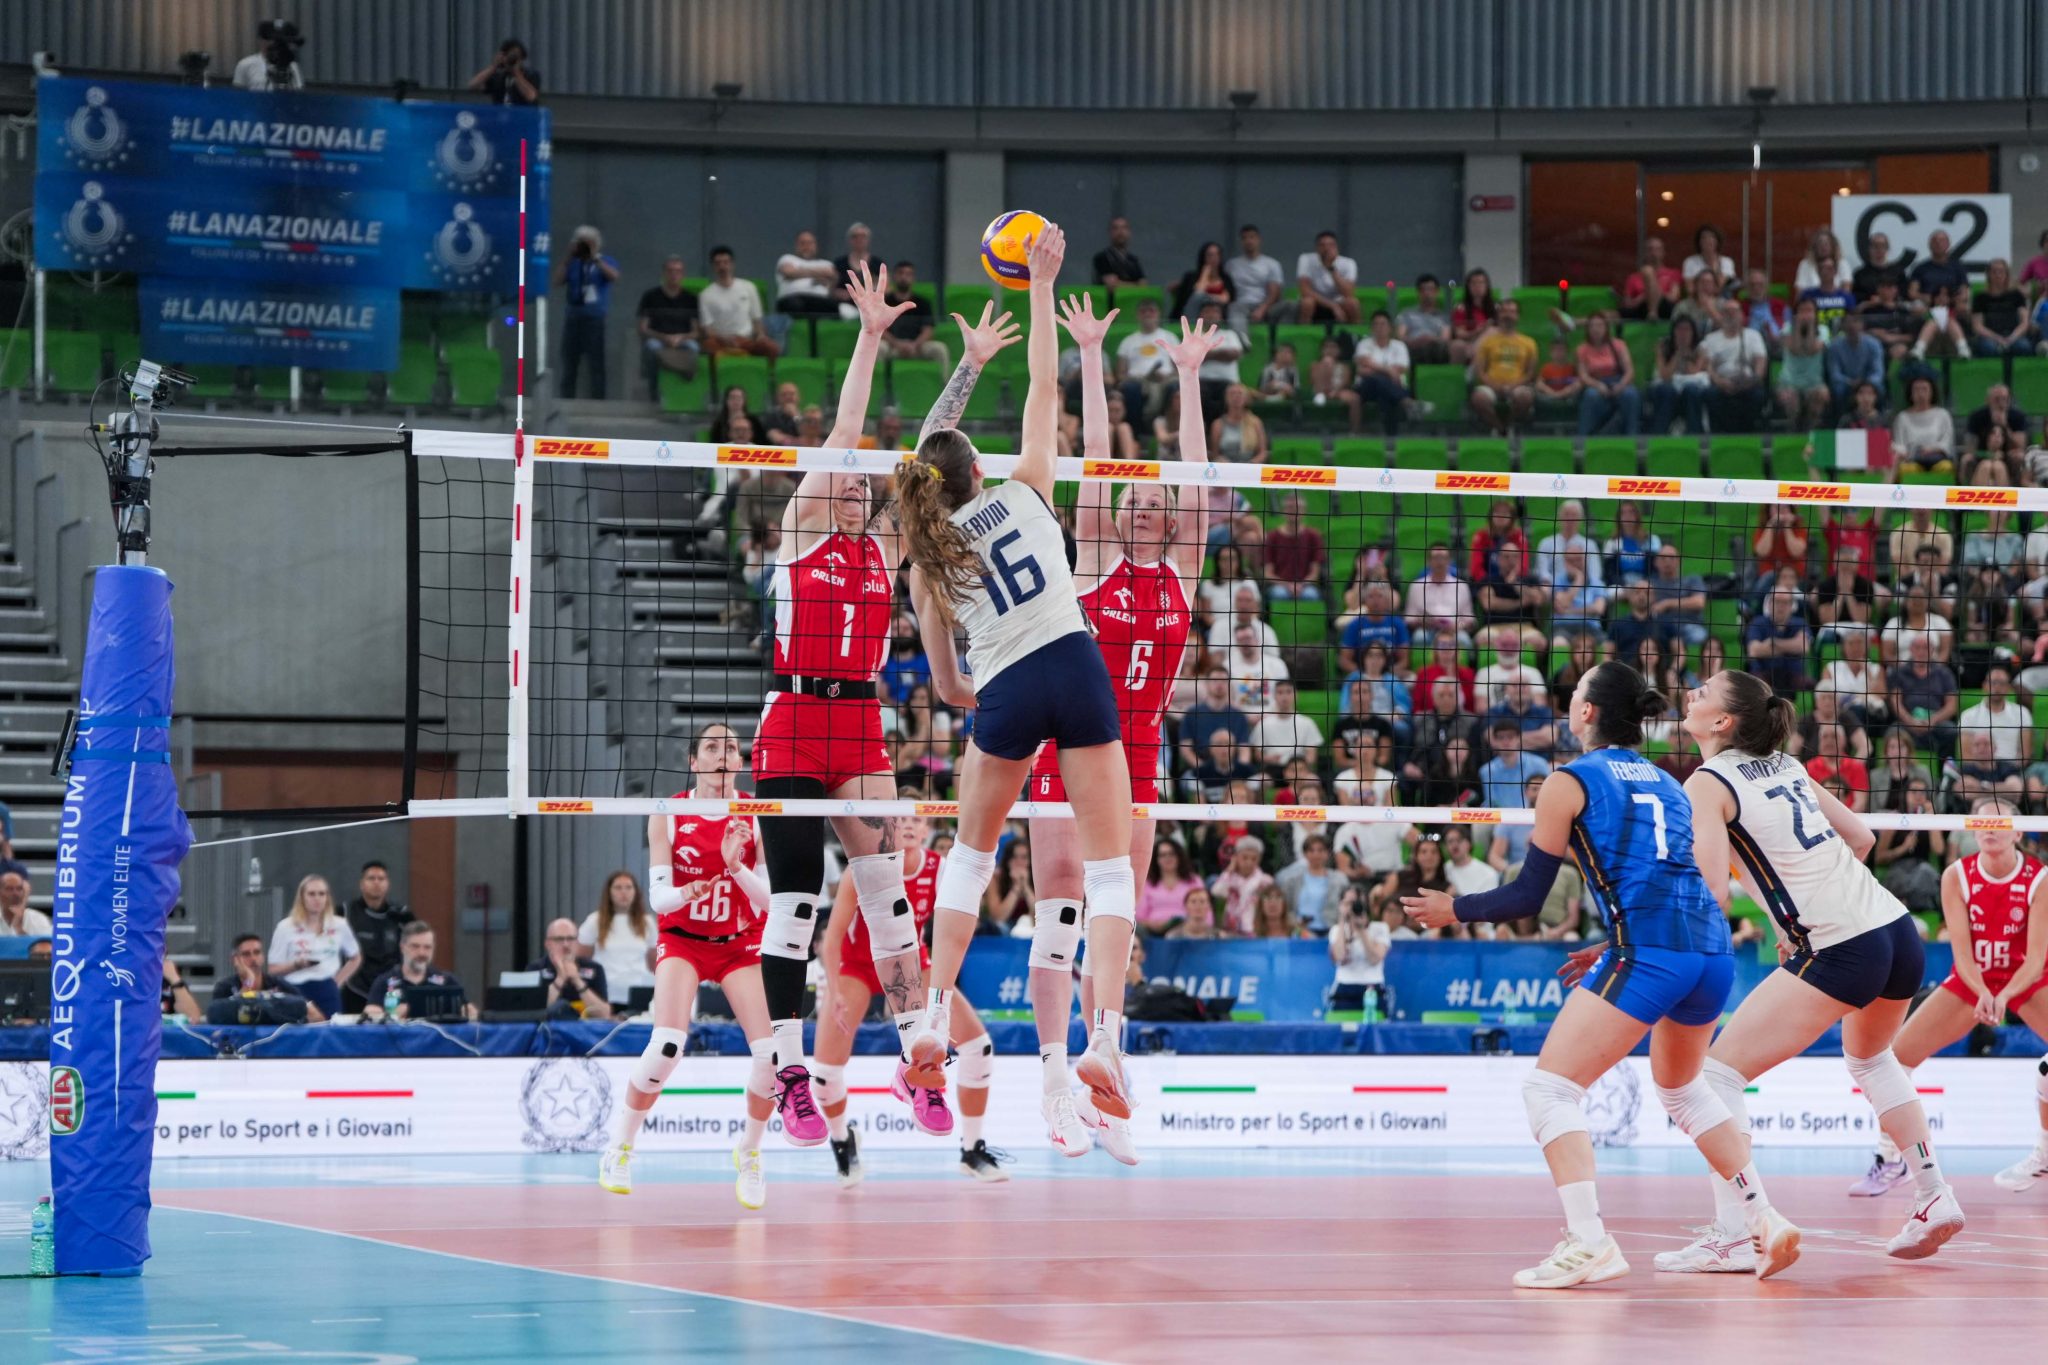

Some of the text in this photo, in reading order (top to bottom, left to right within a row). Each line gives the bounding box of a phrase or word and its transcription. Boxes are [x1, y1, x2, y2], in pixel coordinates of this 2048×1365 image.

[170, 116, 387, 150] #LANAZIONALE
[167, 211, 383, 243] #LANAZIONALE
[161, 297, 376, 328] #LANAZIONALE
[538, 441, 600, 456] DHL
[728, 449, 785, 464] DHL
[1094, 463, 1150, 477] DHL
[1272, 469, 1325, 483] DHL
[1446, 475, 1499, 489] DHL
[1618, 480, 1671, 493] DHL
[1787, 486, 1840, 499] DHL
[1956, 491, 2008, 504] DHL
[960, 499, 1010, 542] ERVINI
[811, 568, 845, 588] ORLEN
[975, 528, 1046, 617] 16
[862, 579, 886, 595] plus
[1102, 606, 1137, 625] ORLEN
[1156, 613, 1179, 631] plus
[840, 603, 855, 658] 1
[1124, 640, 1154, 691] 6
[1040, 774, 1051, 795] 6
[545, 802, 586, 812] DHL
[736, 803, 775, 813] DHL
[922, 805, 959, 814] DHL
[1282, 809, 1319, 819] DHL
[1458, 811, 1495, 821] DHL
[1632, 793, 1668, 860] 7
[1971, 819, 2006, 828] DHL
[111, 844, 131, 955] WOMEN ELITE
[1975, 939, 2011, 974] 95
[178, 1122, 212, 1143] per
[220, 1120, 237, 1138] lo
[245, 1119, 300, 1142] Sport
[307, 1124, 319, 1138] e
[326, 1119, 331, 1137] i
[338, 1117, 412, 1137] Giovani
[642, 1116, 721, 1134] Ministro
[728, 1119, 746, 1137] pe
[865, 1115, 869, 1131] i
[876, 1114, 915, 1132] Giov
[1161, 1112, 1447, 1135] Ministro per lo Sport e i Giovani
[1780, 1112, 1795, 1130] lo
[1801, 1112, 1848, 1134] Sport
[1854, 1117, 1864, 1130] e
[1870, 1113, 1874, 1130] i
